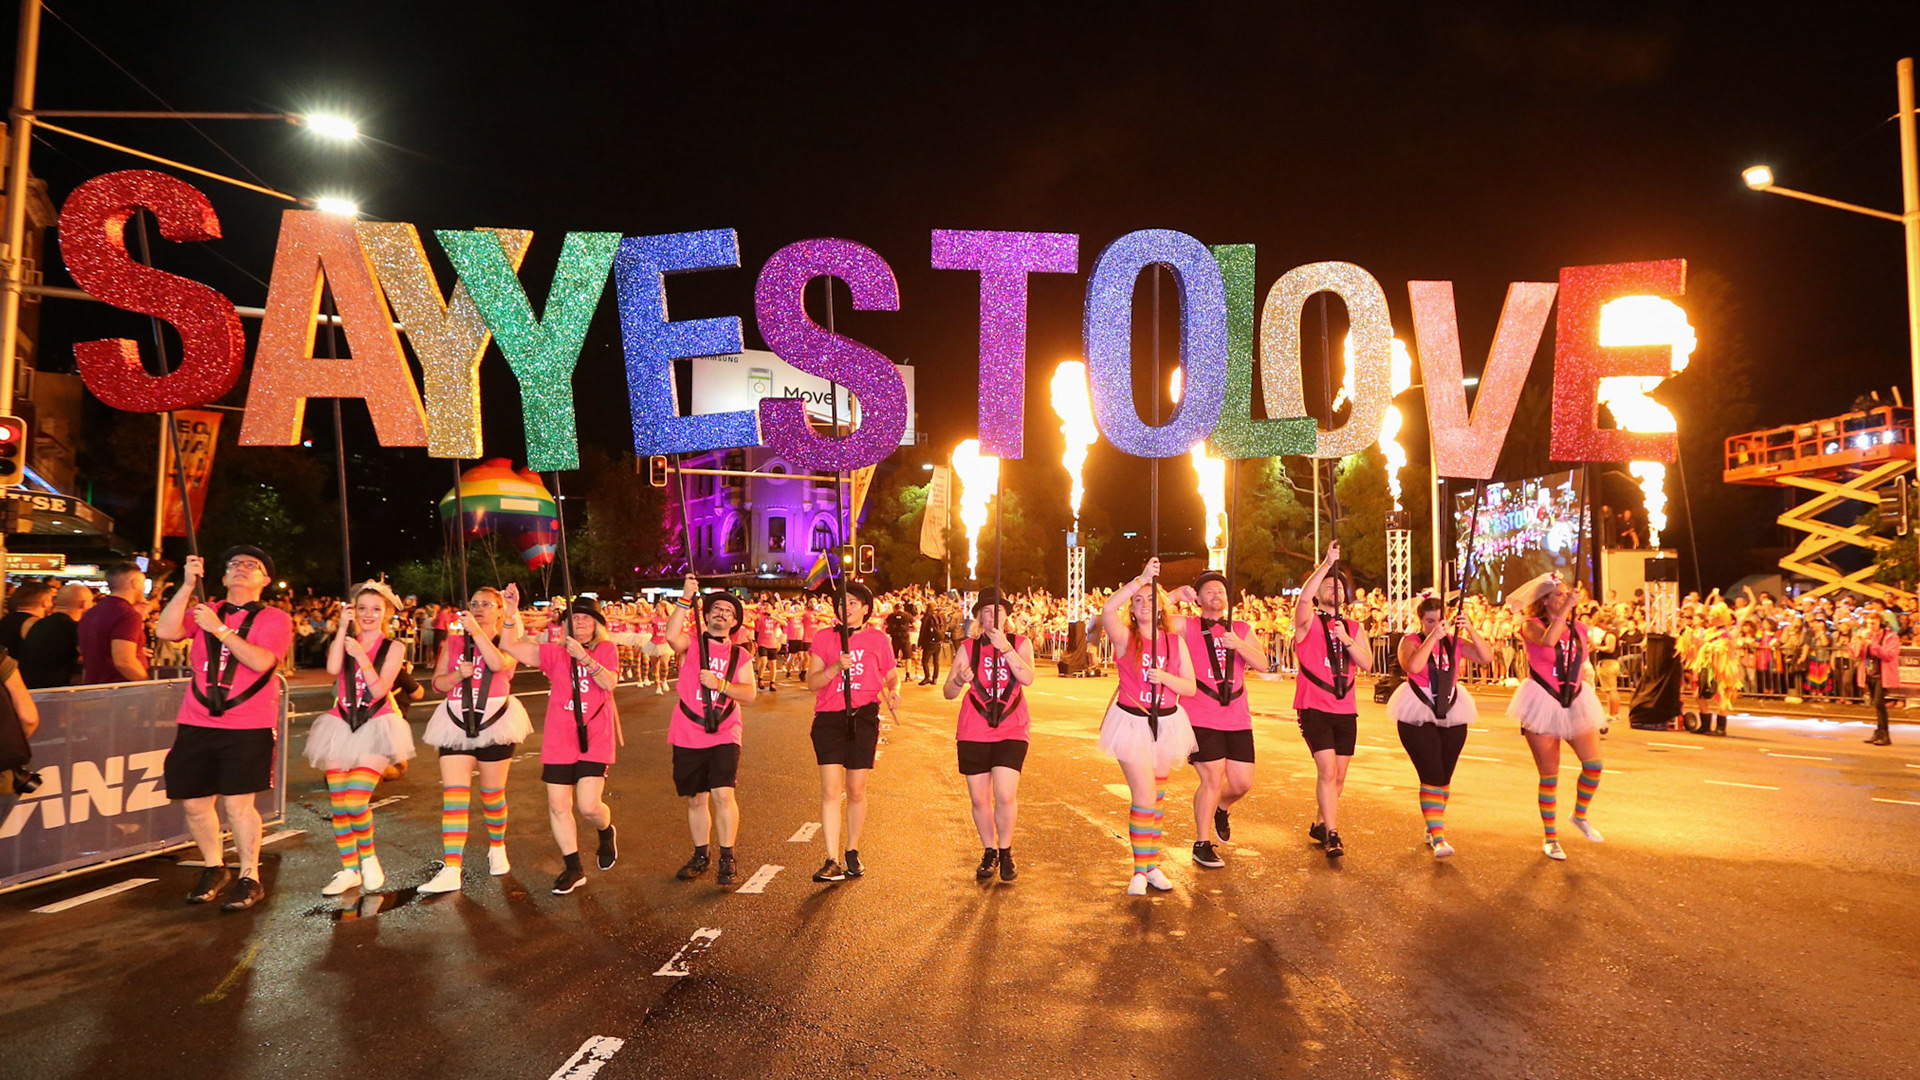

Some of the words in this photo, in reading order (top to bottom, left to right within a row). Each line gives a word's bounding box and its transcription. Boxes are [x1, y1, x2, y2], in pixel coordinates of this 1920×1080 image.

[58, 169, 534, 459] SAY
[435, 229, 908, 473] YES
[931, 228, 1228, 460] TO
[1209, 243, 1688, 480] LOVE
[783, 385, 833, 405] Move
[1142, 653, 1166, 669] SY
[0, 748, 172, 839] ANZ
